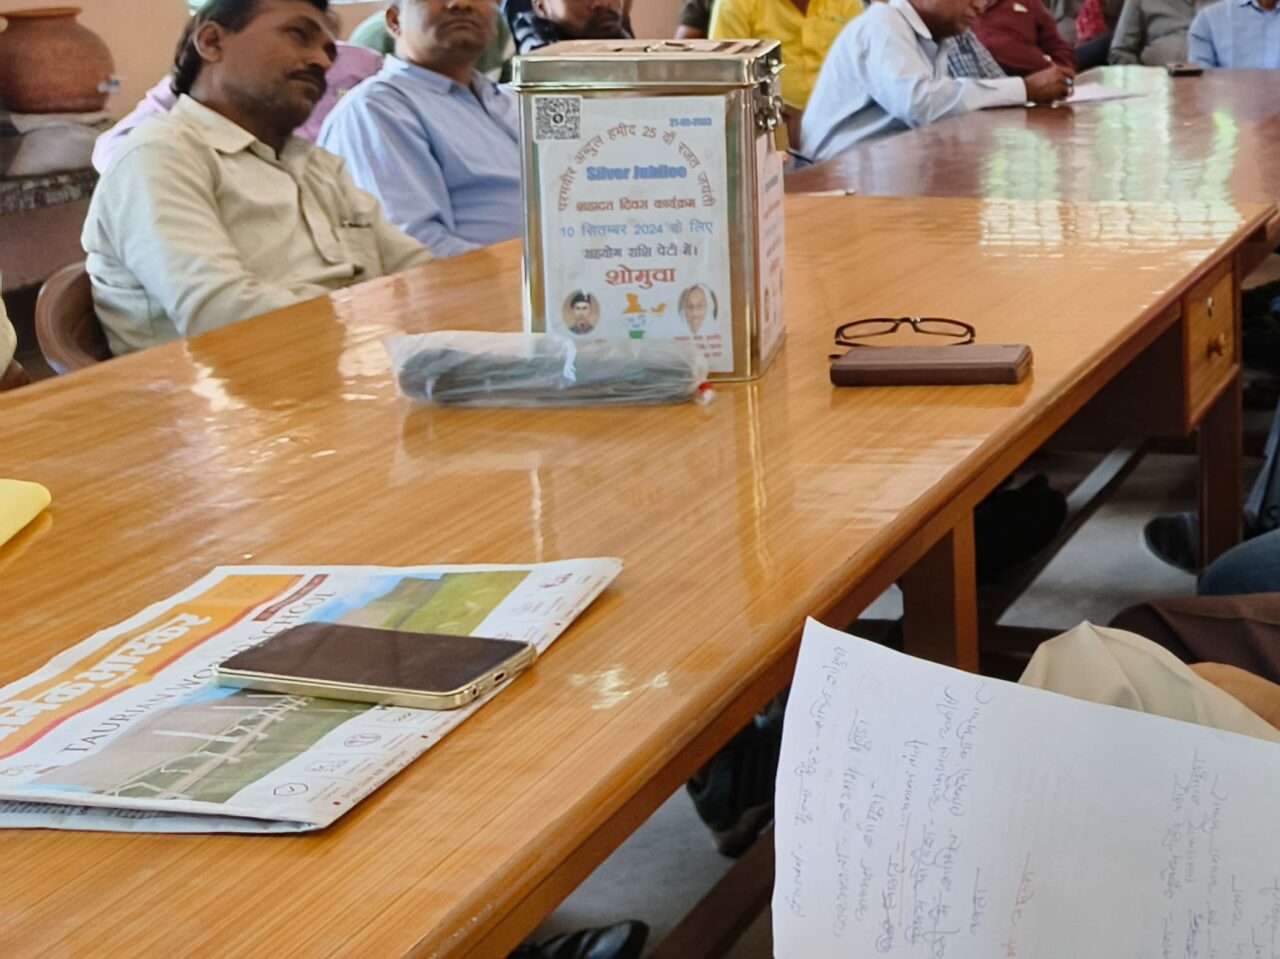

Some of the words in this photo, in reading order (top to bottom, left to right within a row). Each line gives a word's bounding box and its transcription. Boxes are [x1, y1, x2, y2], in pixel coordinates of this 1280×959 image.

[642, 126, 656, 138] 25
[586, 166, 630, 181] Silver
[633, 164, 687, 179] Jubilee
[561, 227, 575, 238] 10
[634, 223, 664, 235] 2024
[690, 218, 714, 234] लिए
[628, 243, 652, 257] राशि
[657, 242, 677, 256] पेटी
